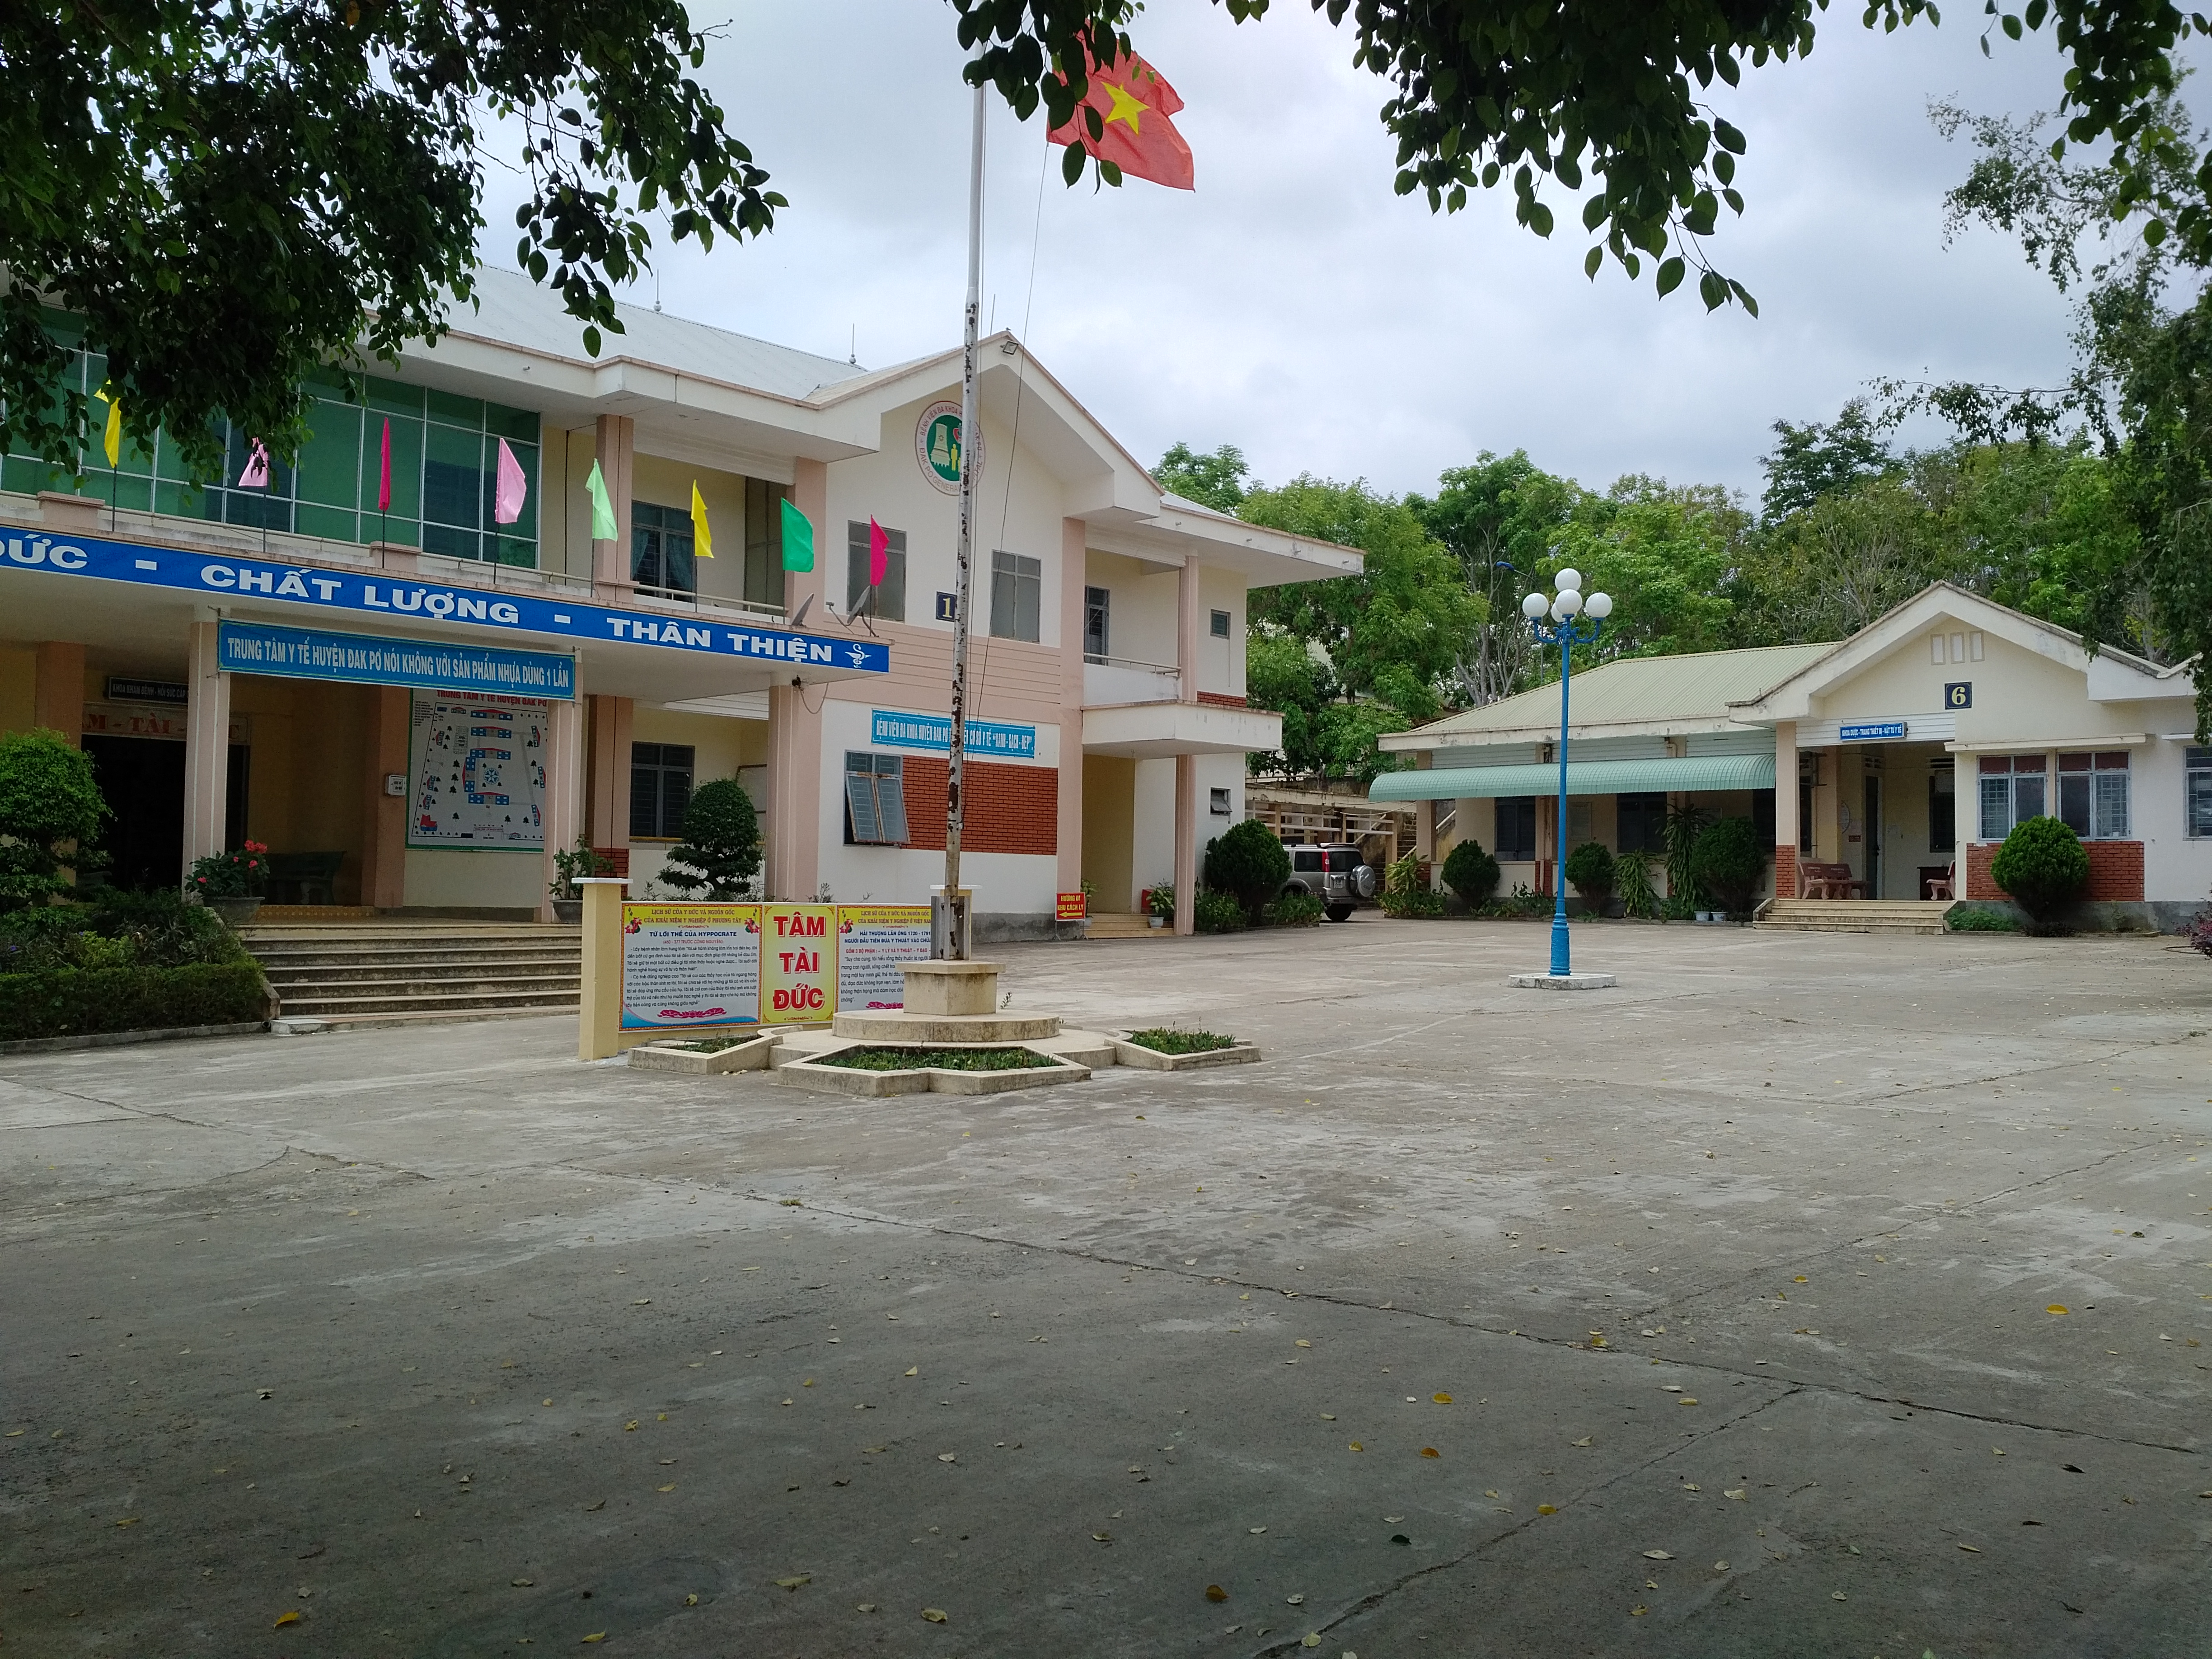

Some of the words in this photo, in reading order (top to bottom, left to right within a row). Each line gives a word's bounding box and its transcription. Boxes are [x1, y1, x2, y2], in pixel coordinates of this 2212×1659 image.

[201, 565, 342, 601] CHẤT
[364, 586, 519, 623] LƯỢNG
[607, 617, 711, 647] THÂN
[727, 633, 832, 662] THIỆN
[942, 597, 952, 618] 1
[228, 637, 262, 660] TRUNG
[265, 637, 286, 663] TÂM
[288, 643, 295, 663] Y
[297, 636, 310, 665] TẾ
[313, 642, 345, 673] HUYỆN
[348, 649, 367, 670] ĐAK
[369, 648, 381, 671] PƠ
[384, 647, 400, 672] NÓI
[402, 651, 434, 675] KHÔNG
[436, 652, 450, 677] VỚI
[453, 652, 470, 679] SẢN
[472, 652, 496, 681] PHẨM
[498, 661, 521, 689] NHỰA
[522, 661, 545, 686] DÙNG
[546, 668, 551, 686] 1
[553, 661, 568, 688] LẦN
[1951, 686, 1966, 705] 6
[773, 911, 825, 937] TÂM
[779, 947, 819, 973] TÀI
[773, 983, 825, 1010] ĐỨC
